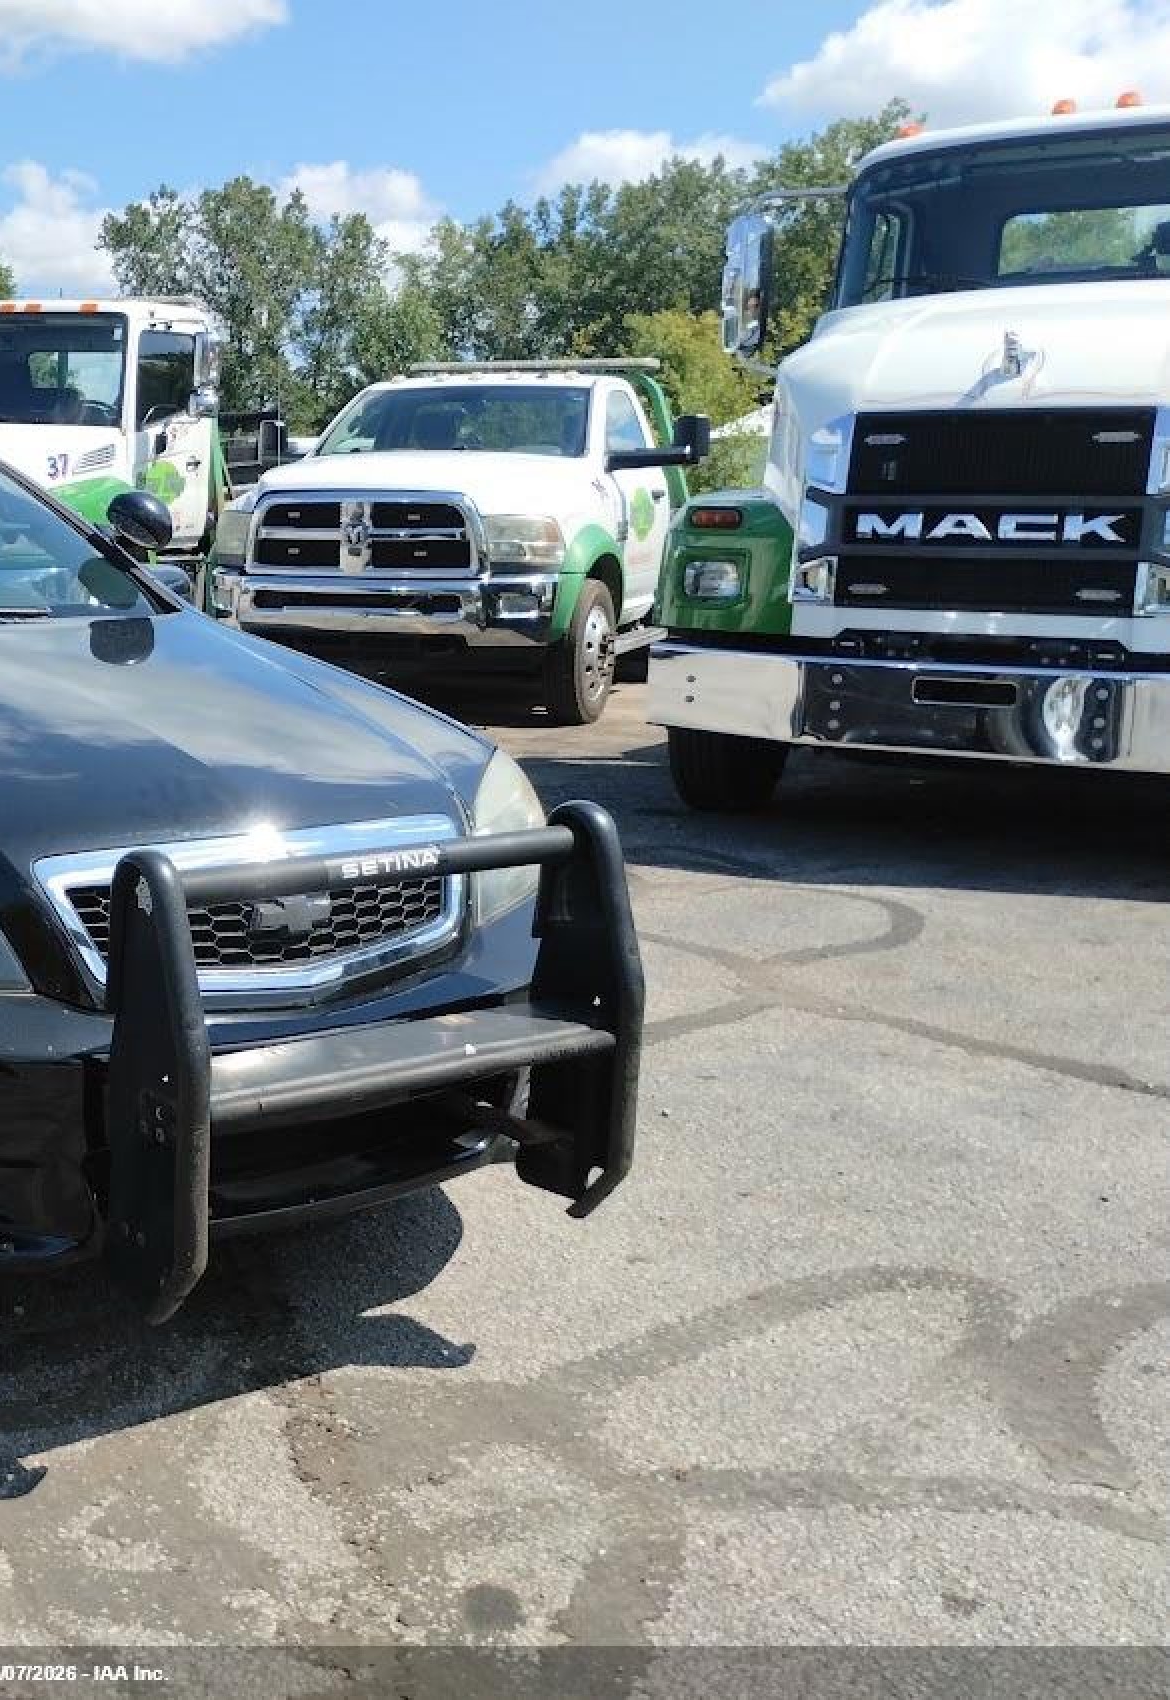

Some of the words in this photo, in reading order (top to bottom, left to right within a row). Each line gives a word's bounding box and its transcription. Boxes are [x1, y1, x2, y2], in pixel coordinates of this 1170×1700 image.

[48, 453, 68, 478] 37
[856, 513, 1127, 542] MACK
[341, 845, 439, 879] SETINA
